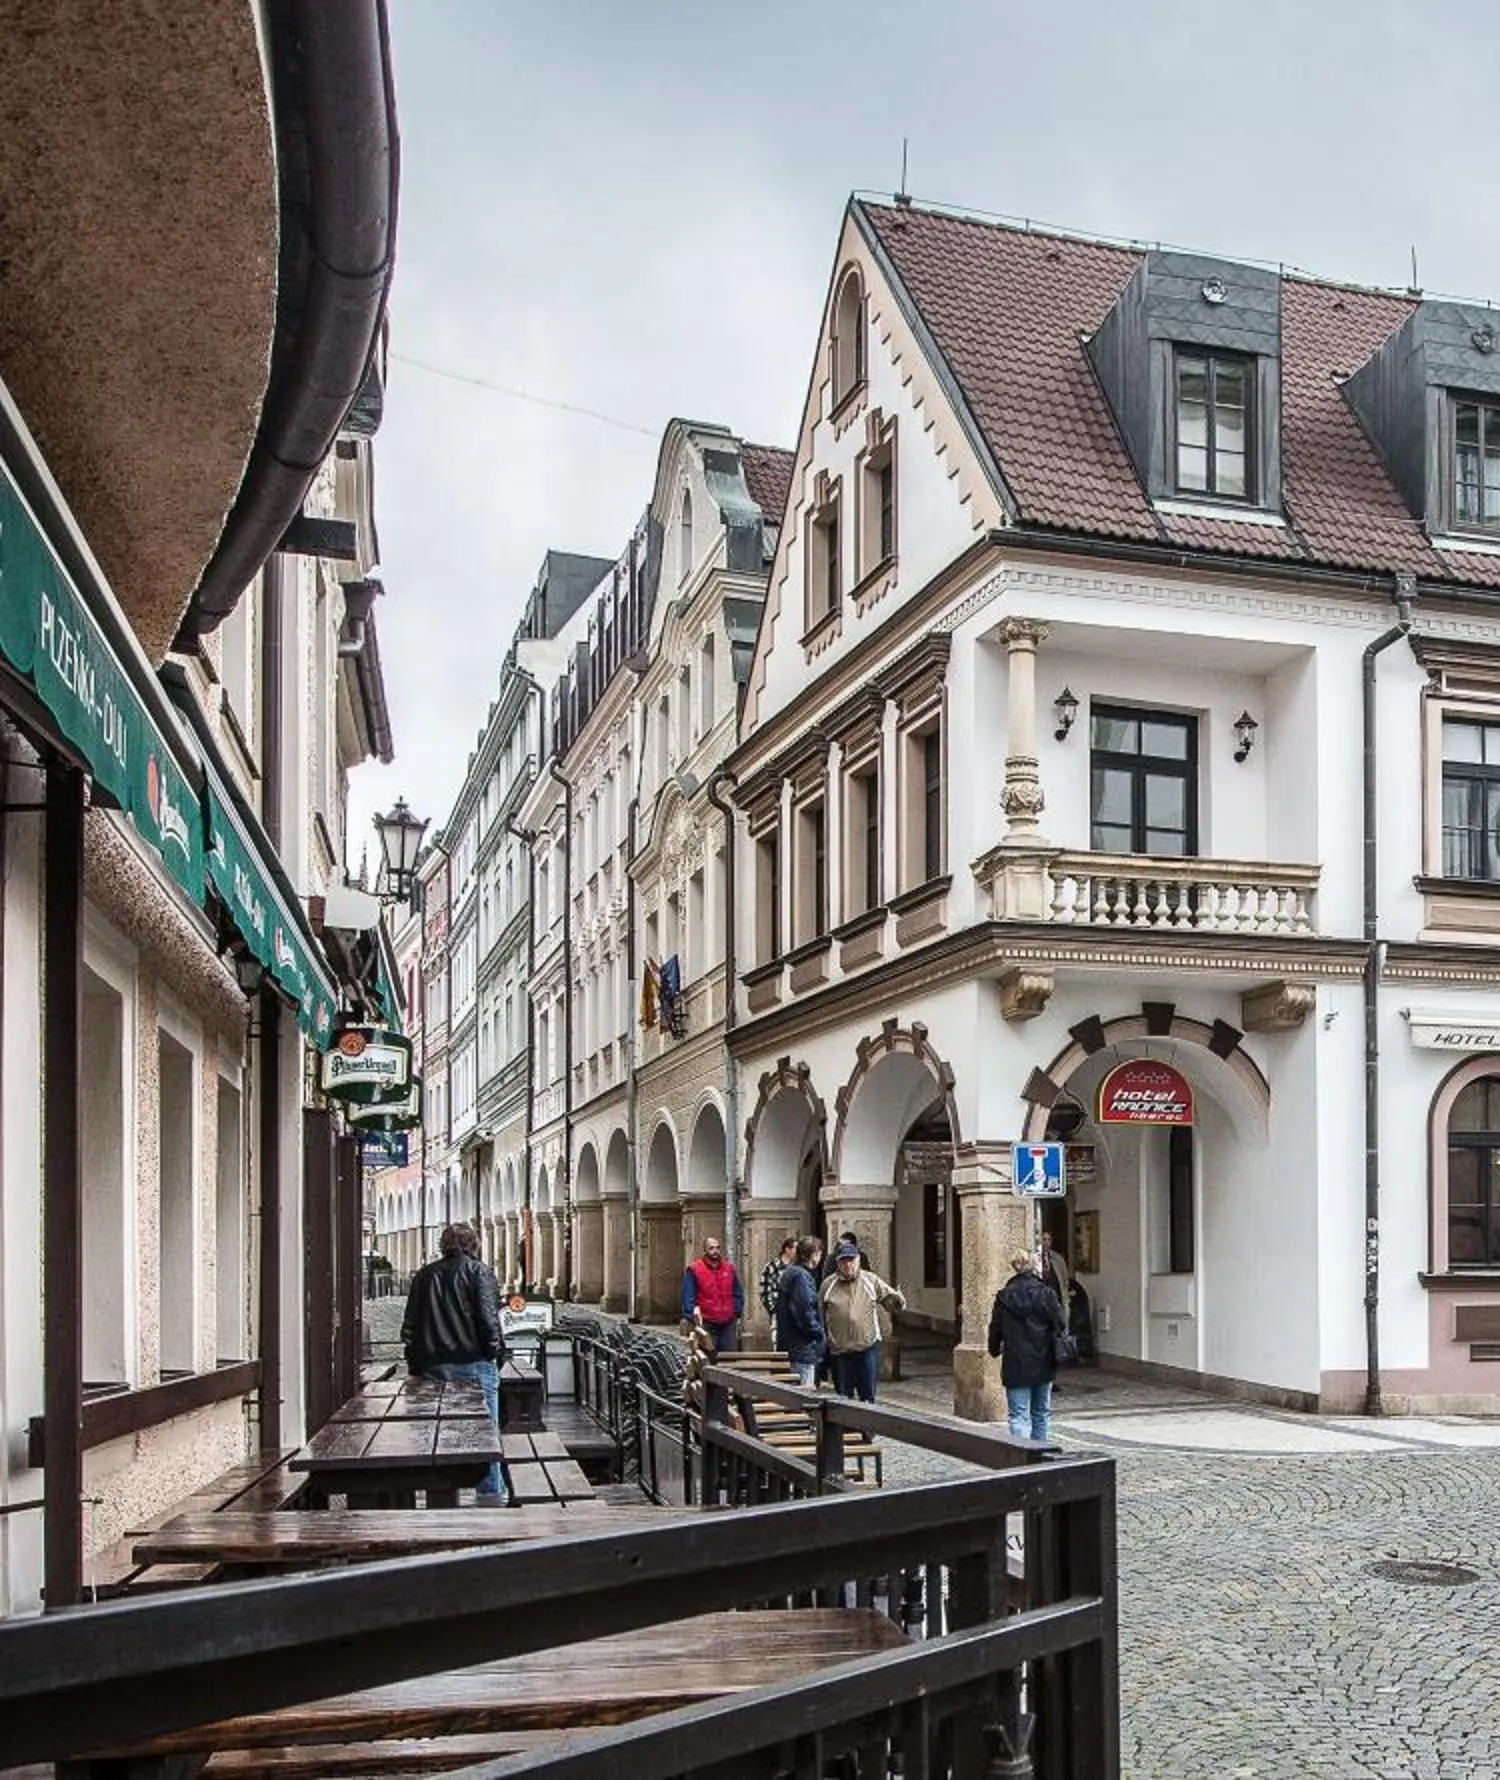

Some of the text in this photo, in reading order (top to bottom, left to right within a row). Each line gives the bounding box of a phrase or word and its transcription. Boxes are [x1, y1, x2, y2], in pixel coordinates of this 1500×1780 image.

[1434, 1033, 1500, 1047] HOTEL
[1113, 1088, 1177, 1101] hotel
[1110, 1101, 1187, 1113] RADNICE
